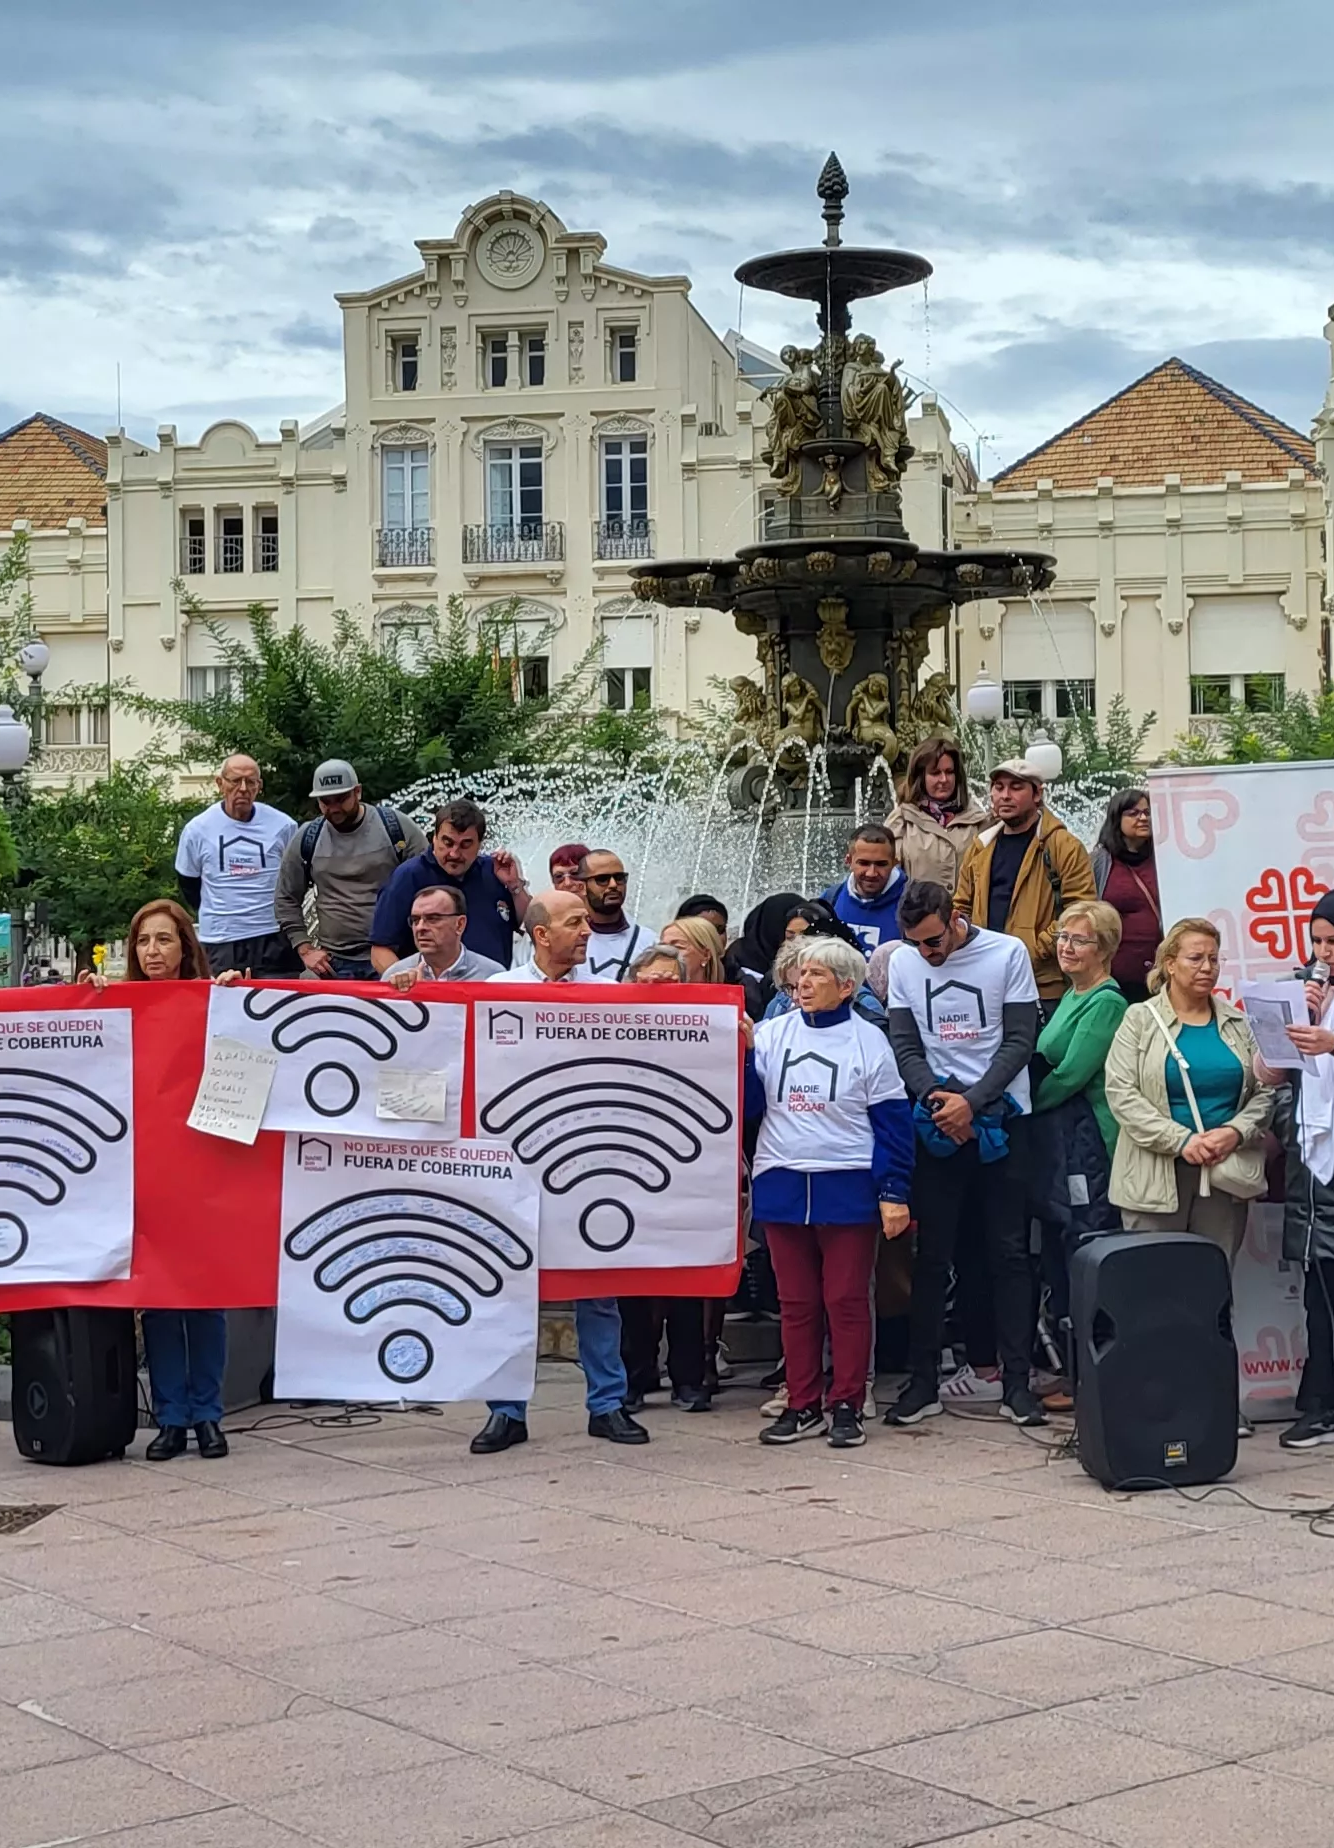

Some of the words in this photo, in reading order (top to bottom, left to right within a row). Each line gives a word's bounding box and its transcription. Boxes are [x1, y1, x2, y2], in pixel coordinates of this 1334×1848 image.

[535, 1012, 555, 1024] NO
[559, 1012, 601, 1025] DEJES
[603, 1012, 631, 1026] QUE
[635, 1013, 652, 1025] SE
[655, 1013, 710, 1026] QUEDEN
[939, 1013, 970, 1024] NADIE
[27, 1021, 45, 1034] SE
[47, 1020, 104, 1032] QUEDEN
[939, 1024, 957, 1032] SIN
[535, 1026, 587, 1040] FUERA
[591, 1028, 612, 1040] DE
[615, 1028, 710, 1042] COBERTURA
[939, 1031, 980, 1042] HOGAR
[7, 1035, 105, 1050] COBERTURA
[789, 1084, 820, 1094] NADIE
[788, 1094, 806, 1102] SIN
[787, 1102, 826, 1112] HOGAR
[343, 1141, 364, 1152] NO
[367, 1142, 407, 1155] DEJES
[411, 1145, 437, 1158] QUE
[440, 1147, 457, 1158] SE
[459, 1148, 514, 1162] QUEDEN
[343, 1154, 395, 1171] FUERA
[397, 1158, 418, 1172] DE
[421, 1159, 513, 1180] COBERTURA
